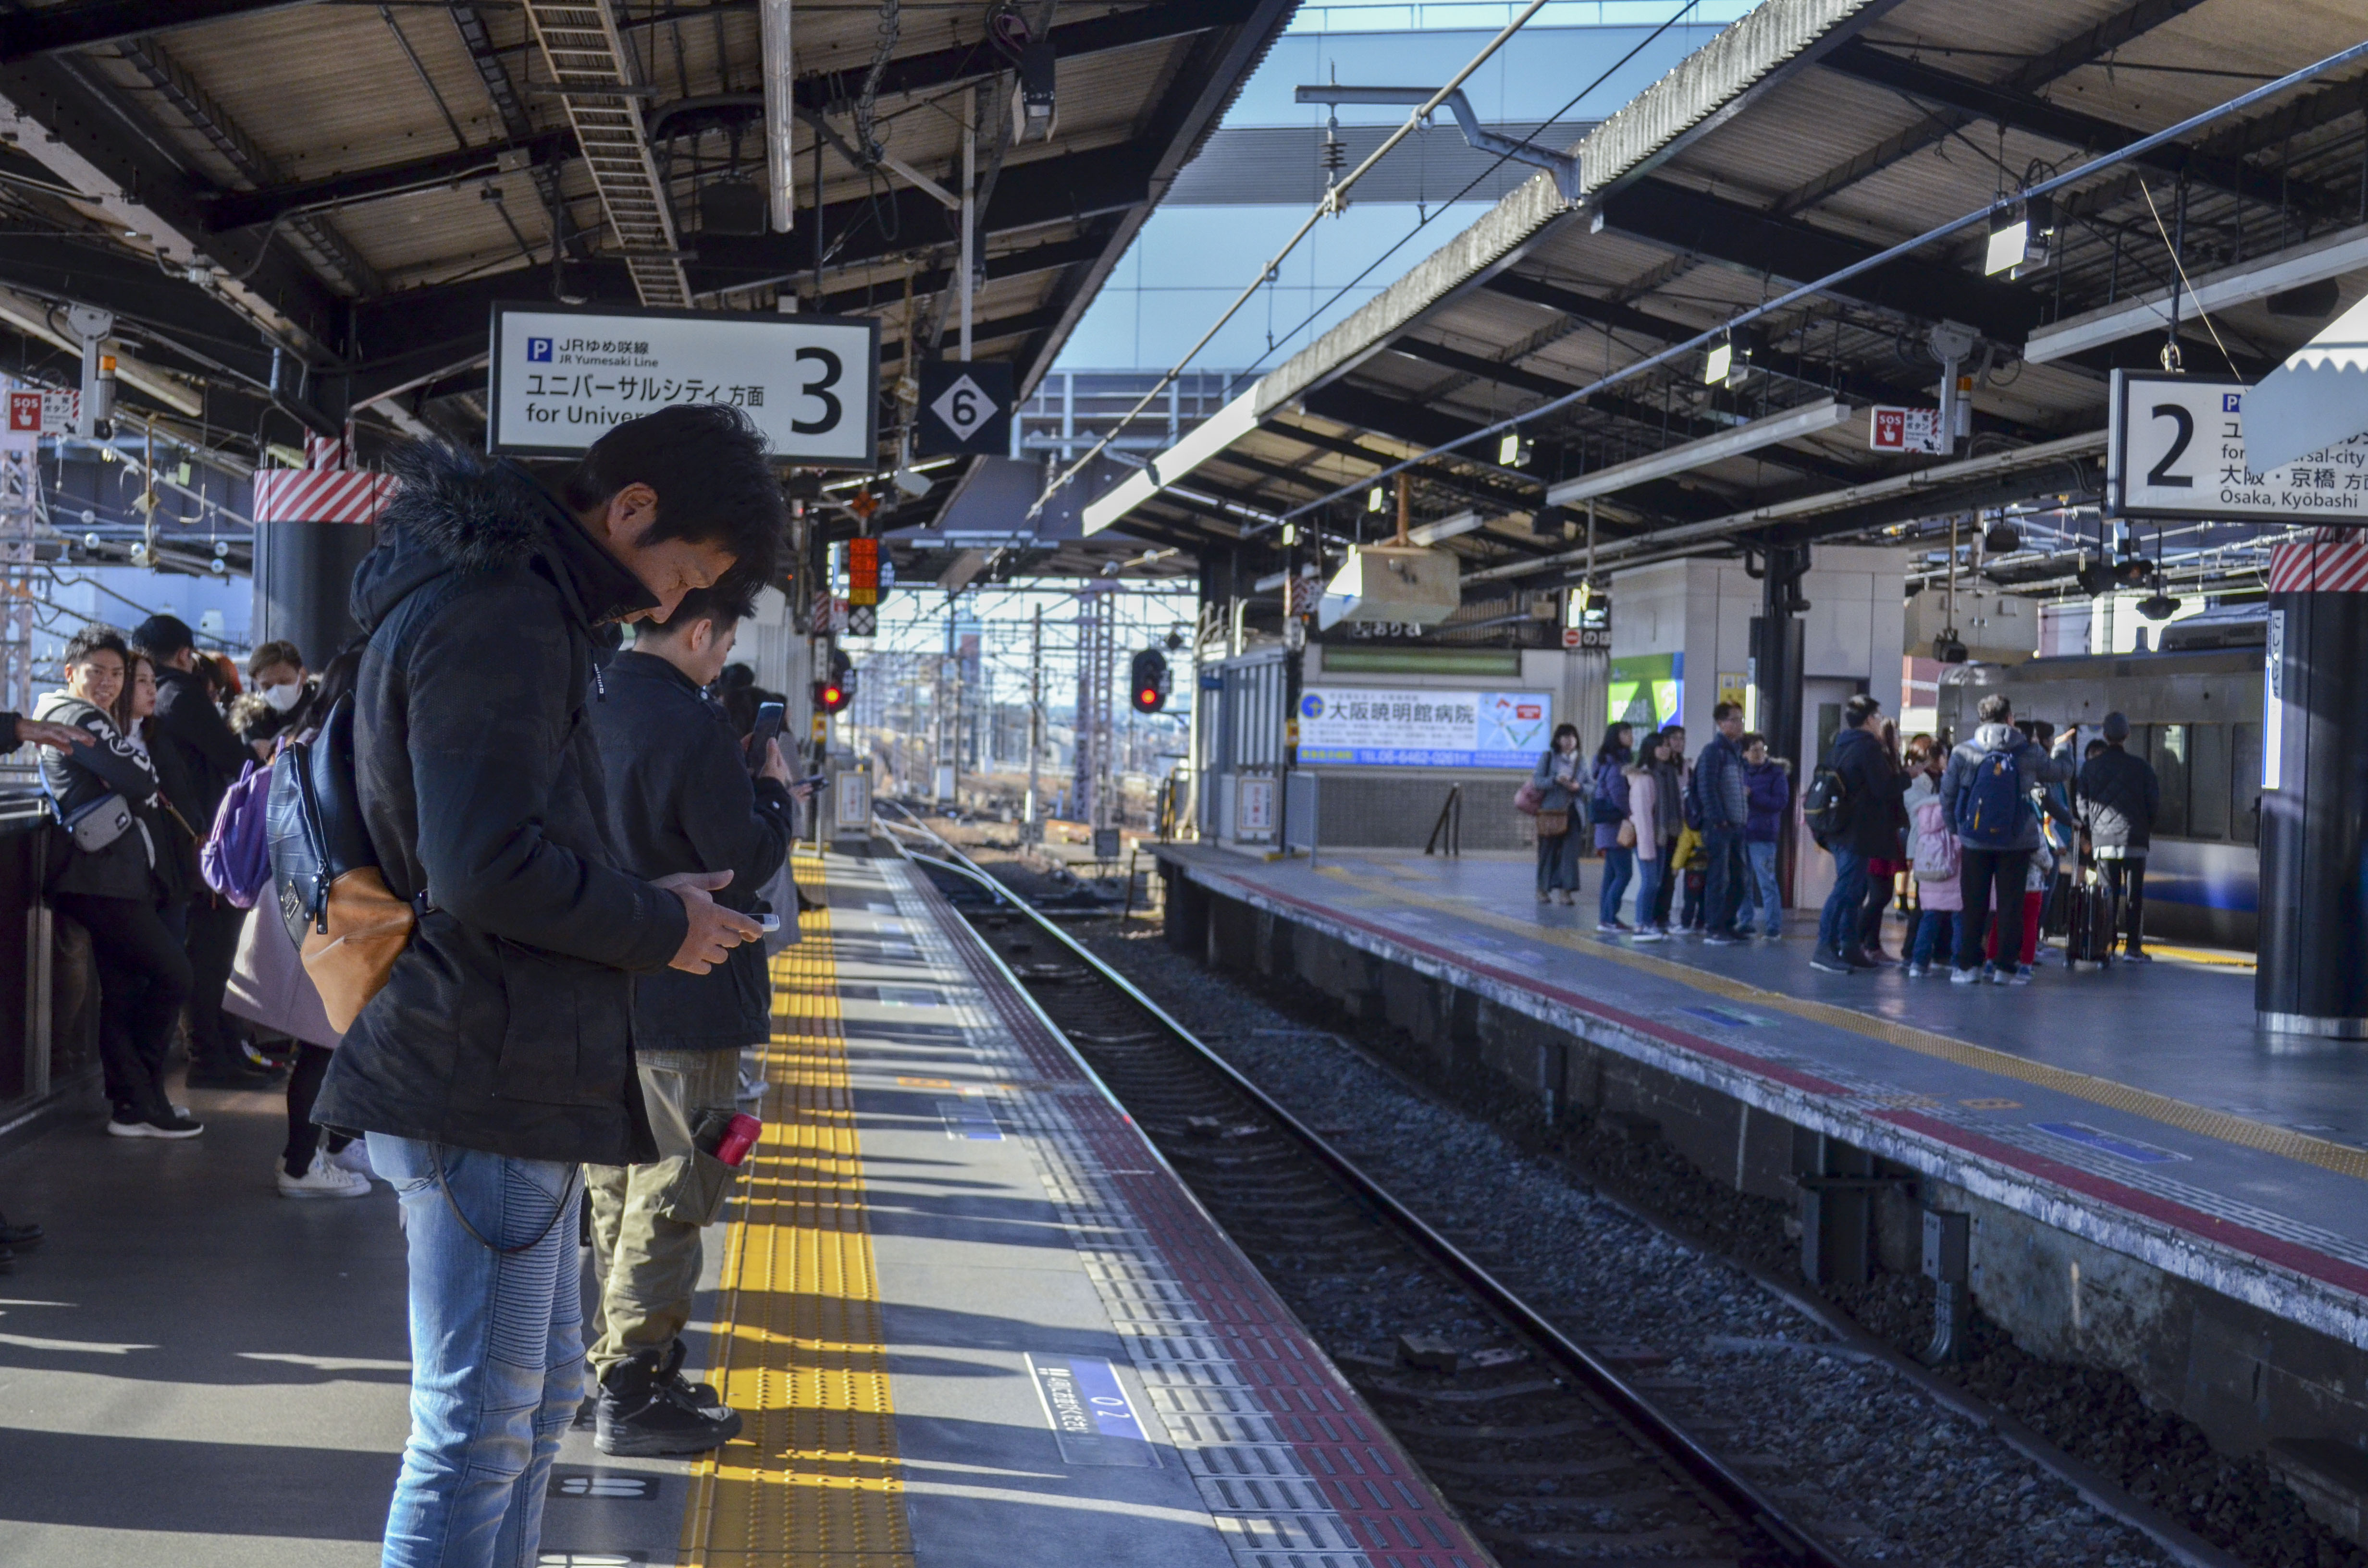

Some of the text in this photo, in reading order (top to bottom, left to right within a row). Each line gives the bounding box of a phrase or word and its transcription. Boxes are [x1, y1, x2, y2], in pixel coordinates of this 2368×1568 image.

[559, 339, 649, 355] JRゆめ咲線
[559, 355, 658, 368] JR Yumesaki Line
[791, 346, 843, 435] 3
[13, 398, 38, 408] SOS
[952, 389, 977, 426] 6
[526, 403, 560, 422] for
[1879, 415, 1901, 426] SOS
[2147, 404, 2194, 488] 2
[2222, 444, 2245, 460] for
[2220, 486, 2358, 510] Ōsaka, Kyōbashi
